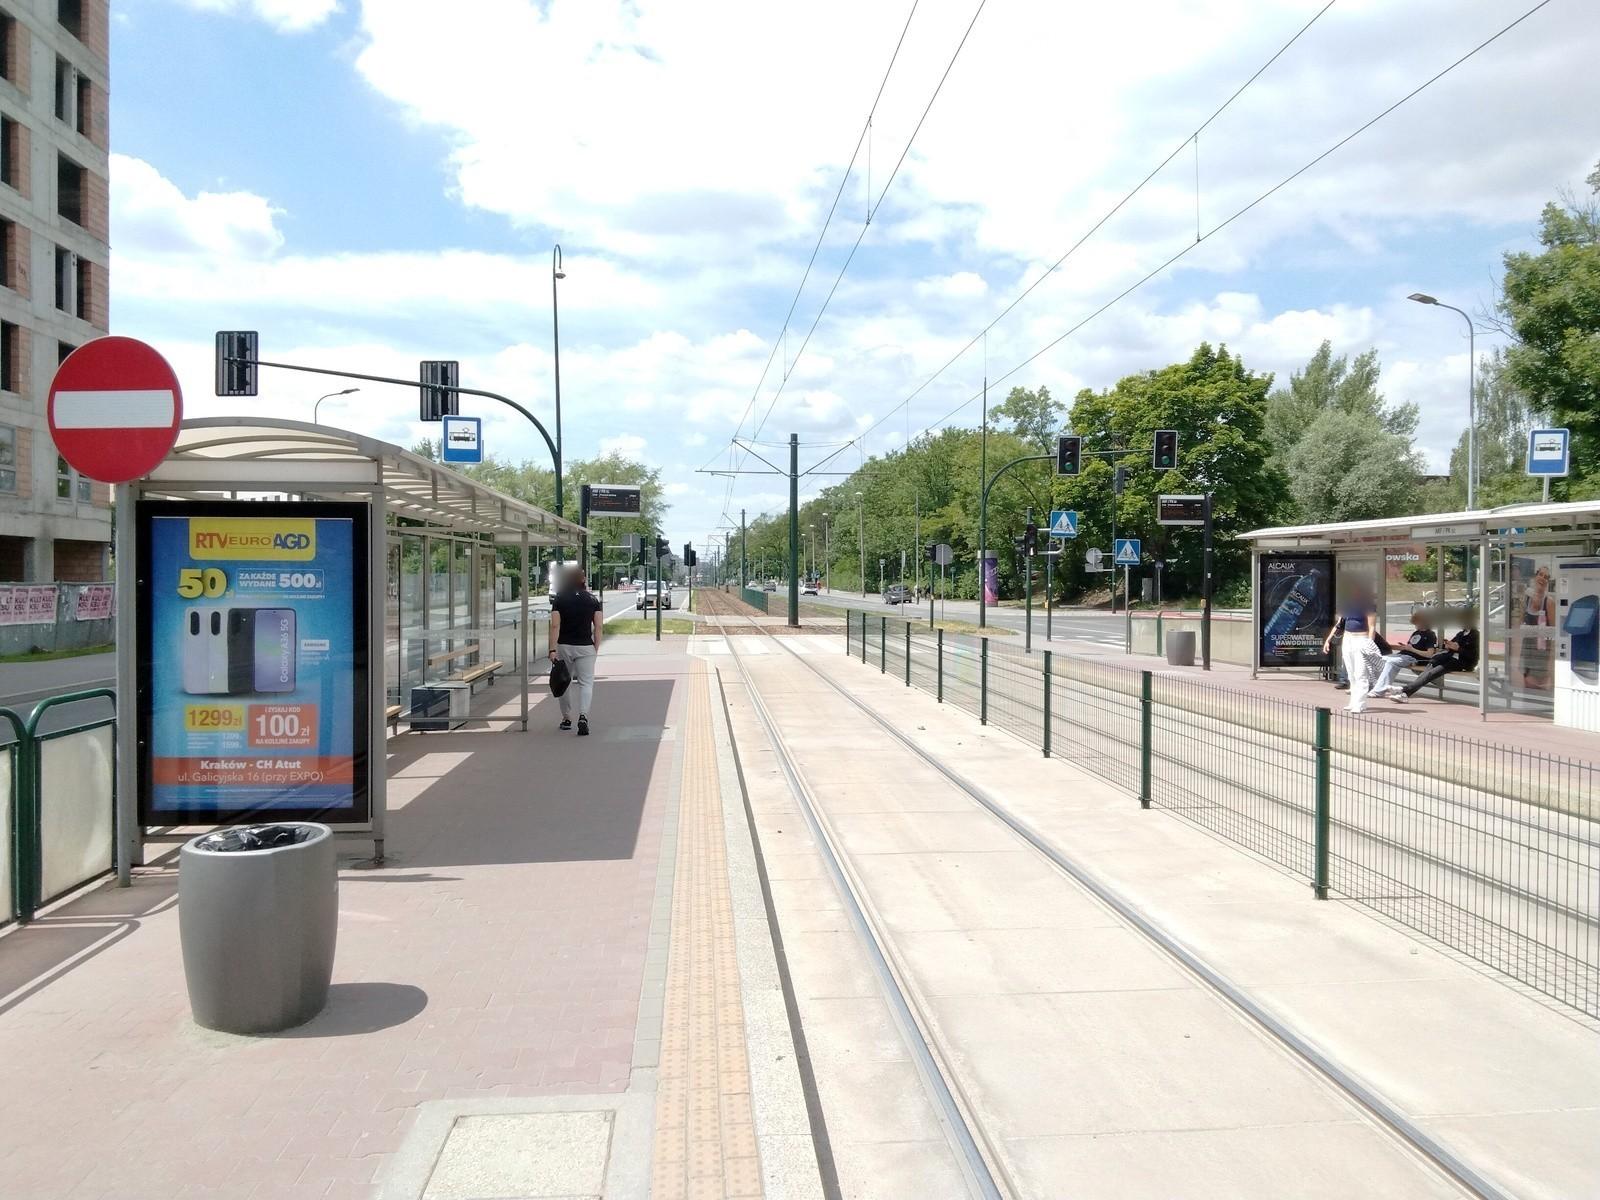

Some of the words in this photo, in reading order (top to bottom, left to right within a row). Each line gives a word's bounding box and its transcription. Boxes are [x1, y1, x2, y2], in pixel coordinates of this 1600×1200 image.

[195, 533, 227, 549] RTV
[229, 536, 271, 546] EURO
[273, 533, 310, 550] AGD
[1386, 552, 1419, 561] owska
[251, 571, 276, 580] KAŻDE
[177, 568, 227, 598] 50
[239, 580, 276, 588] WYDANE
[280, 619, 289, 631] 5G
[280, 632, 289, 650] A36
[280, 650, 290, 683] Galaxy
[255, 714, 299, 737] 100
[201, 760, 247, 769] Kraków
[256, 760, 272, 769] CH
[275, 760, 301, 769] Atut
[178, 774, 190, 782] ul.
[192, 772, 244, 784] Galicyjska
[248, 772, 260, 782] 16
[262, 772, 287, 784] (przy
[289, 772, 324, 783] EXPO)
